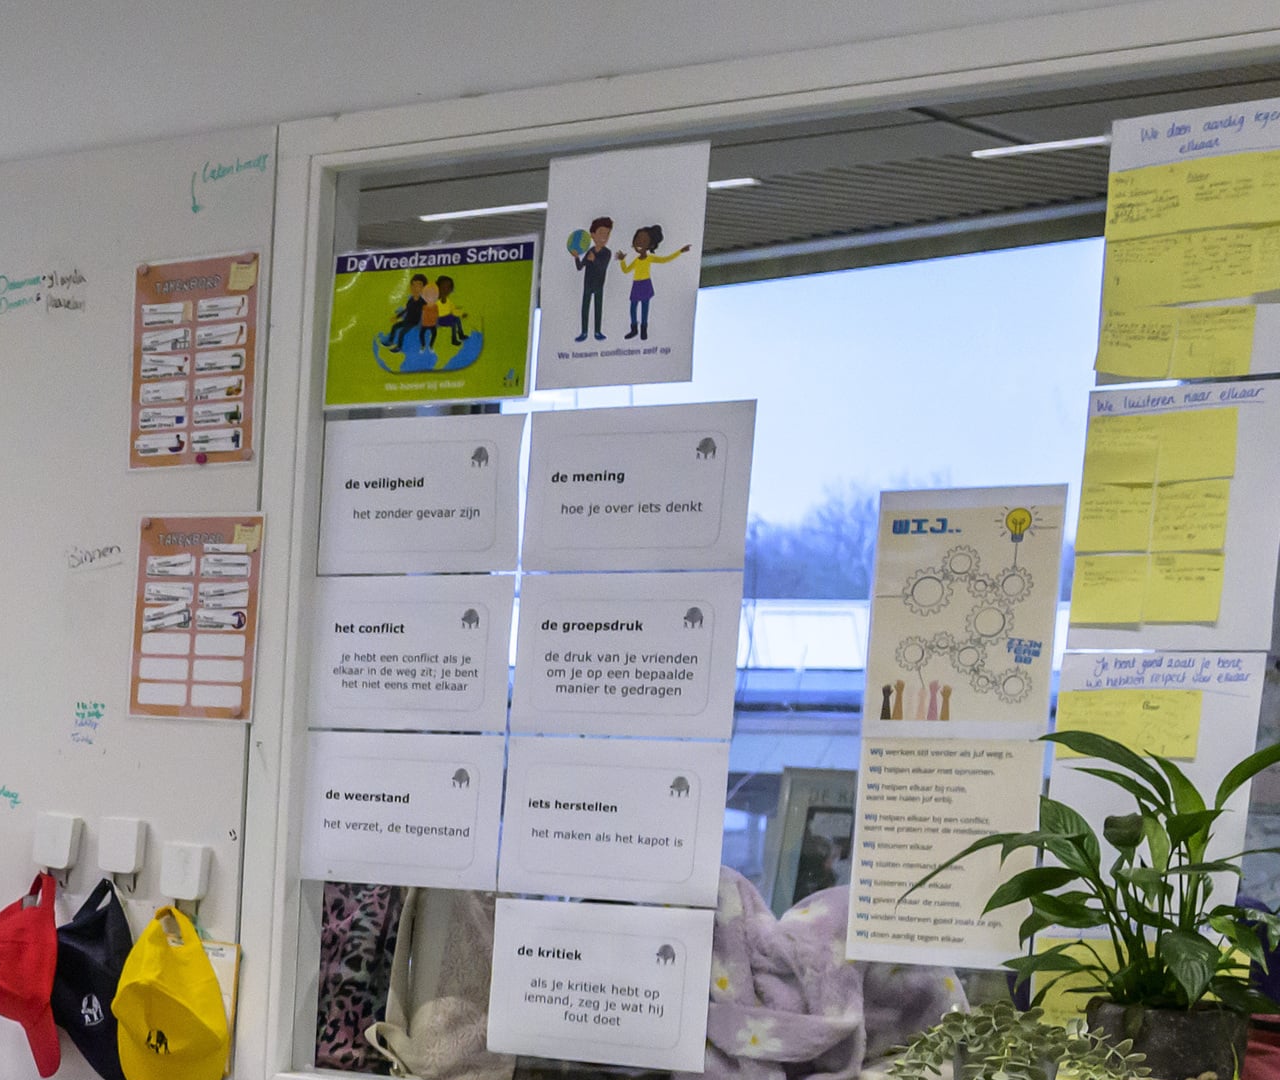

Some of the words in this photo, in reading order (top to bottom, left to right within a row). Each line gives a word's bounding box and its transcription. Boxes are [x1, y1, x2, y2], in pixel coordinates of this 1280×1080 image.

[1141, 128, 1158, 142] We
[347, 257, 368, 272] De
[373, 249, 462, 269] Vreedzame
[467, 244, 524, 265] School
[600, 348, 641, 357] conflicten
[643, 346, 658, 354] zelf
[660, 347, 671, 355] op
[1096, 399, 1113, 412] We
[1123, 393, 1175, 409] luisteren
[1184, 390, 1212, 405] naar
[1219, 386, 1265, 400] elkaar
[552, 472, 567, 483] de
[573, 470, 624, 483] mening
[345, 480, 359, 489] de
[364, 477, 424, 490] veiligheid
[353, 509, 370, 519] het
[375, 508, 413, 519] zonder
[417, 509, 456, 520] gevaar
[460, 507, 480, 520] zijn
[561, 504, 583, 514] hoe
[588, 505, 600, 516] je
[605, 505, 633, 513] over
[638, 503, 661, 513] iets
[666, 501, 702, 512] denkt
[335, 623, 354, 633] het
[359, 623, 404, 633] conflict
[542, 620, 557, 630] de
[563, 620, 642, 632] groepsdruk
[1007, 638, 1042, 648] ZIJN
[545, 651, 559, 662] de
[564, 651, 592, 662] druk
[598, 654, 619, 662] van
[624, 653, 636, 665] je
[642, 653, 697, 664] vrienden
[1007, 646, 1041, 658] TEAM
[340, 654, 350, 664] je
[354, 653, 376, 662] hebt
[402, 653, 438, 663] conflict
[443, 655, 457, 664] als
[461, 656, 471, 666] je
[333, 666, 364, 675] elkaar
[367, 667, 376, 677] in
[380, 667, 392, 676] de
[397, 669, 416, 678] weg
[441, 669, 451, 679] je
[455, 669, 478, 677] bent
[547, 669, 565, 677] om
[570, 668, 582, 680] je
[587, 670, 602, 680] op
[607, 670, 629, 678] een
[635, 668, 693, 681] bepaalde
[342, 679, 357, 688] het
[362, 680, 380, 688] niet
[412, 682, 431, 690] met
[435, 681, 467, 691] elkaar
[556, 685, 599, 694] manier
[604, 684, 616, 694] te
[621, 684, 681, 698] gedragen
[870, 748, 883, 757] Wij
[959, 750, 970, 758] als
[972, 750, 984, 759] juf
[986, 751, 1003, 759] weg
[326, 790, 340, 799] de
[345, 793, 409, 803] weerstand
[529, 799, 550, 808] iets
[555, 800, 617, 812] herstellen
[324, 819, 340, 829] het
[345, 822, 382, 833] verzet,
[388, 823, 401, 833] de
[406, 824, 470, 837] tegenstand
[532, 828, 548, 838] het
[554, 830, 591, 840] maken
[595, 832, 611, 842] als
[616, 833, 632, 843] het
[638, 835, 669, 847] kapot
[674, 838, 683, 847] is
[518, 946, 533, 956] de
[538, 947, 581, 960] kritiek
[531, 978, 547, 988] als
[551, 980, 563, 992] je
[568, 980, 605, 993] kritiek
[612, 984, 638, 997] hebt
[644, 990, 659, 1000] op
[525, 993, 573, 1007] iemand,
[579, 999, 599, 1010] zeg
[605, 999, 616, 1013] je
[621, 1003, 642, 1013] wat
[649, 1004, 663, 1017] hij
[565, 1011, 587, 1023] fout
[593, 1014, 620, 1026] doet
